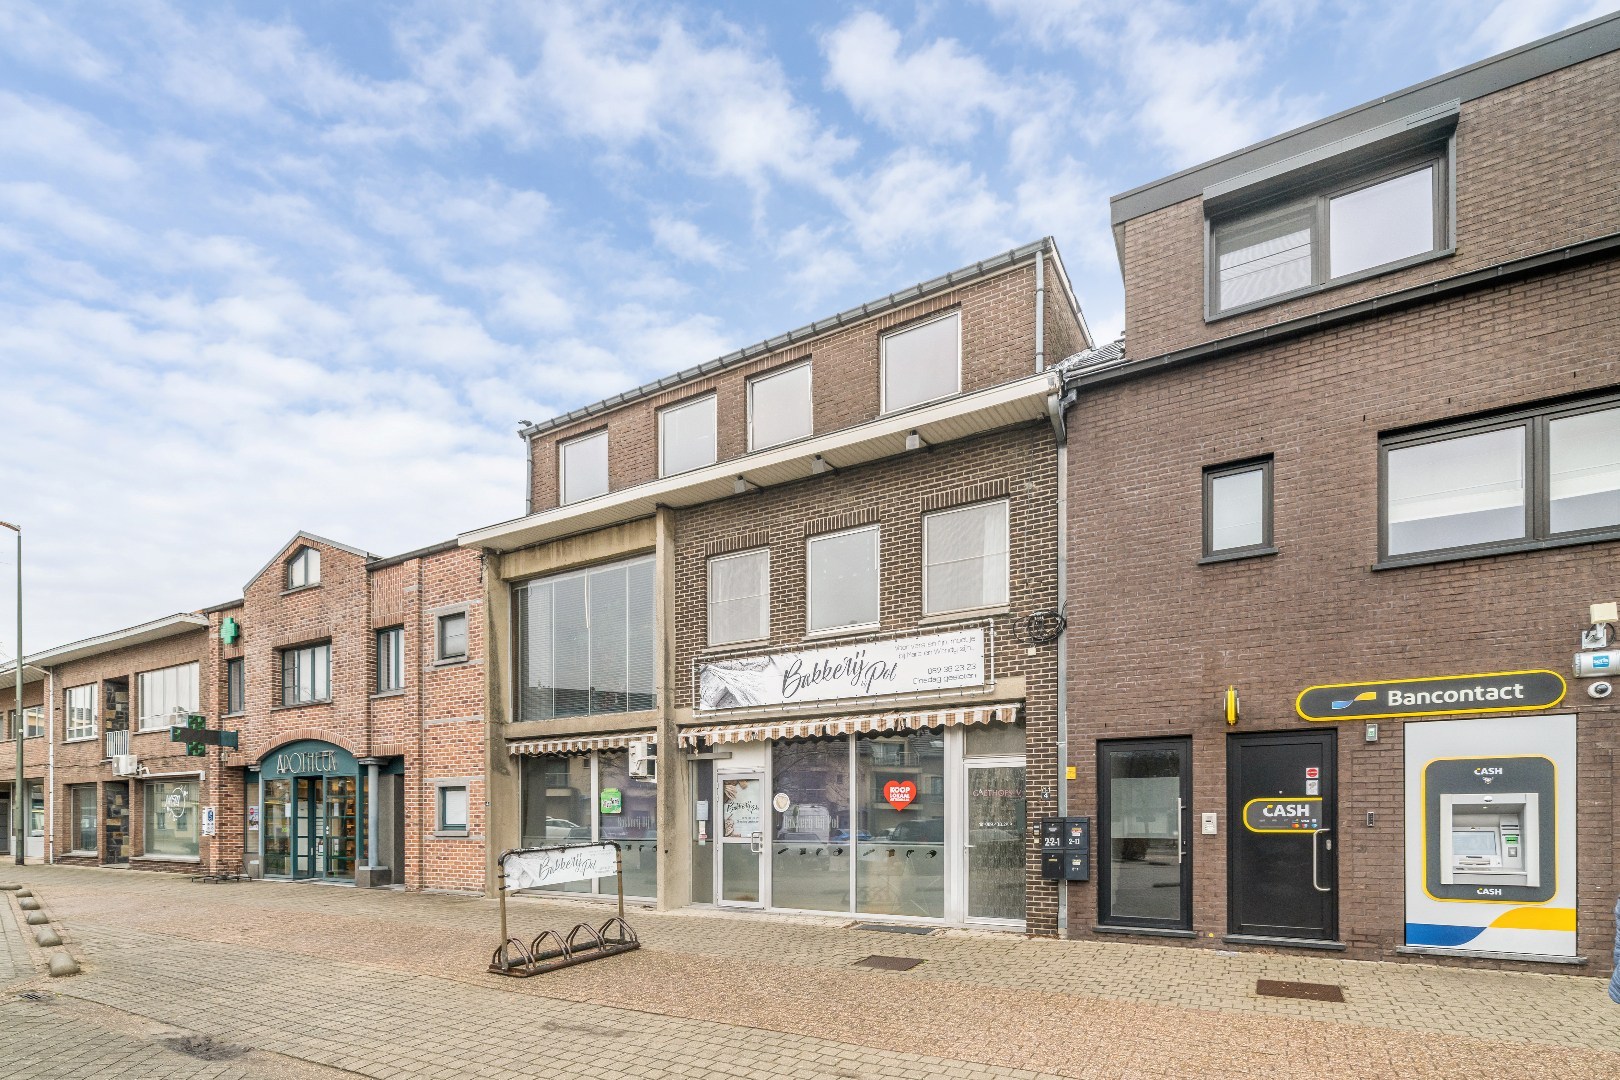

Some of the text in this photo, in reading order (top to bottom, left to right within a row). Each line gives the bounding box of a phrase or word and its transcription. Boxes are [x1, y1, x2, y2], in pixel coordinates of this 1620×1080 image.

[864, 660, 898, 694] Pol
[1387, 683, 1524, 707] Bancontact
[1473, 767, 1503, 775] CASH
[889, 786, 911, 794] KOOP
[1262, 804, 1310, 818] CASH
[1476, 887, 1502, 896] CASH
